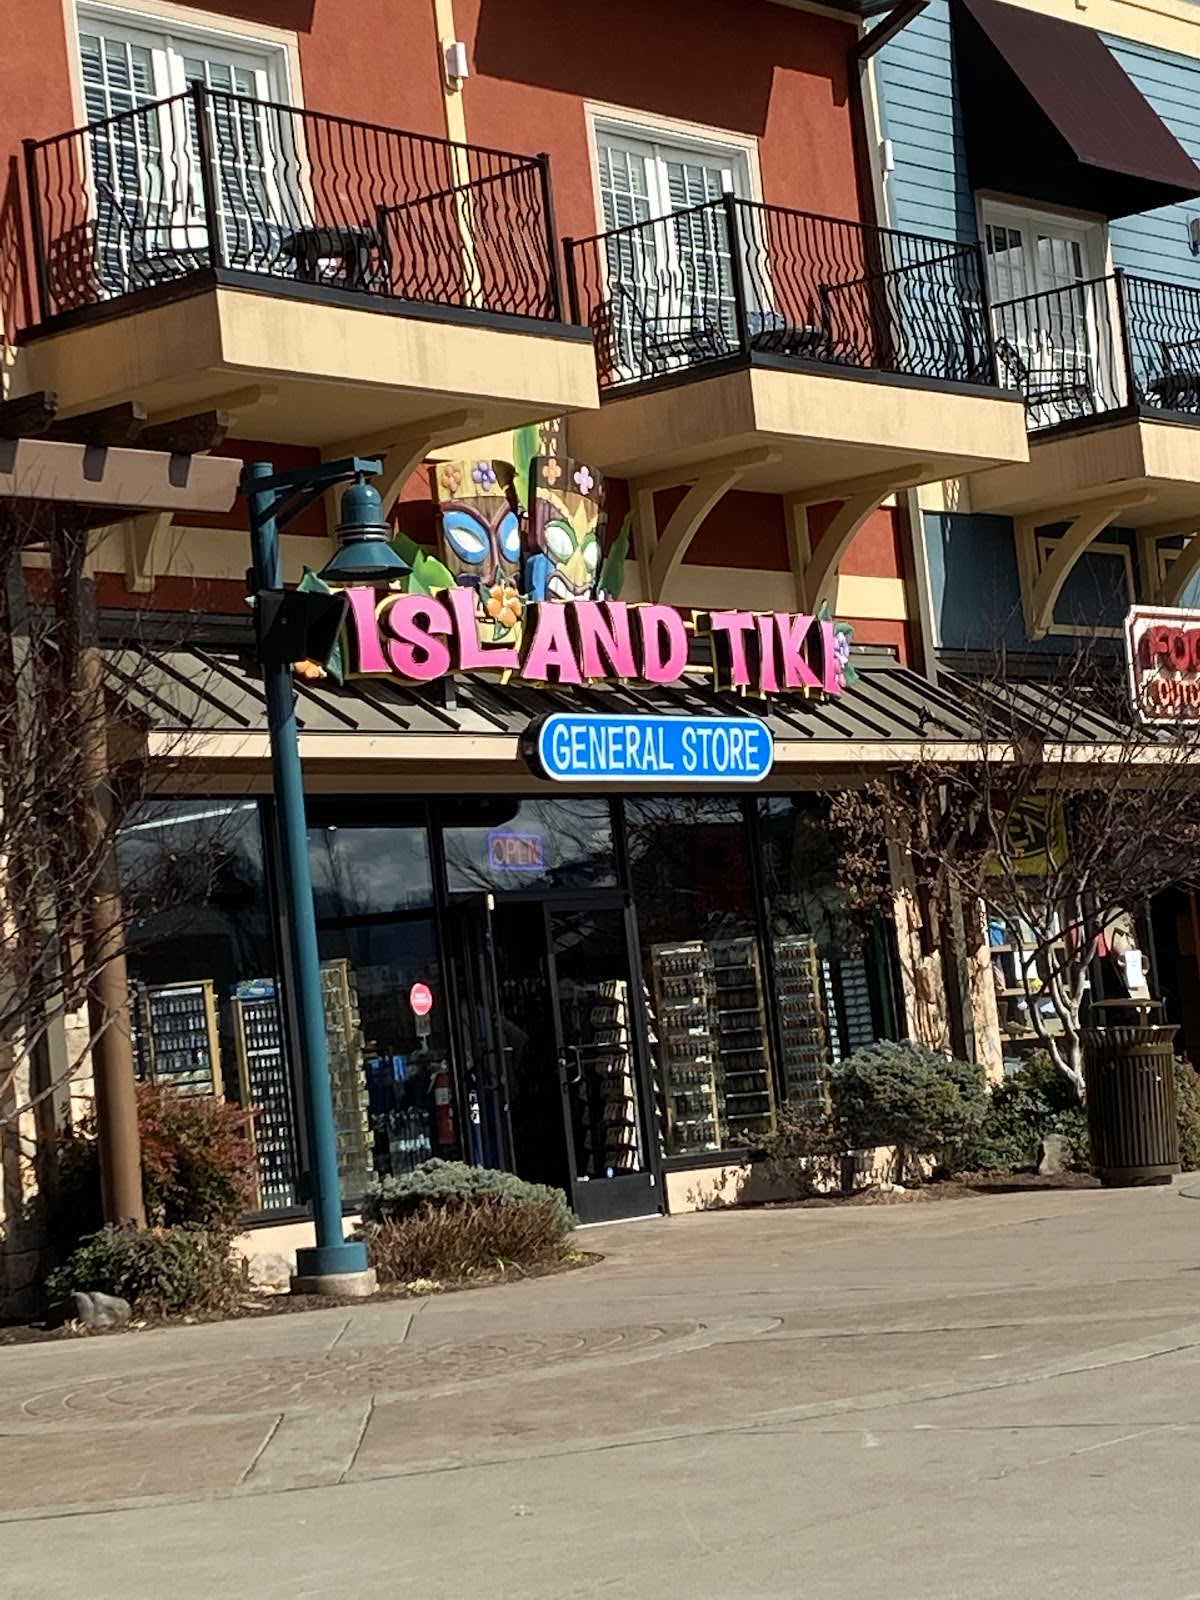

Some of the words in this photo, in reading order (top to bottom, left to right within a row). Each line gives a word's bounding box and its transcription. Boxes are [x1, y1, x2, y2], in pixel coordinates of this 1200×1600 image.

[347, 586, 688, 684] ISLAND
[710, 611, 841, 695] TIKI
[552, 723, 674, 770] GENERAL
[682, 726, 760, 771] STORE
[492, 838, 542, 864] OPEN
